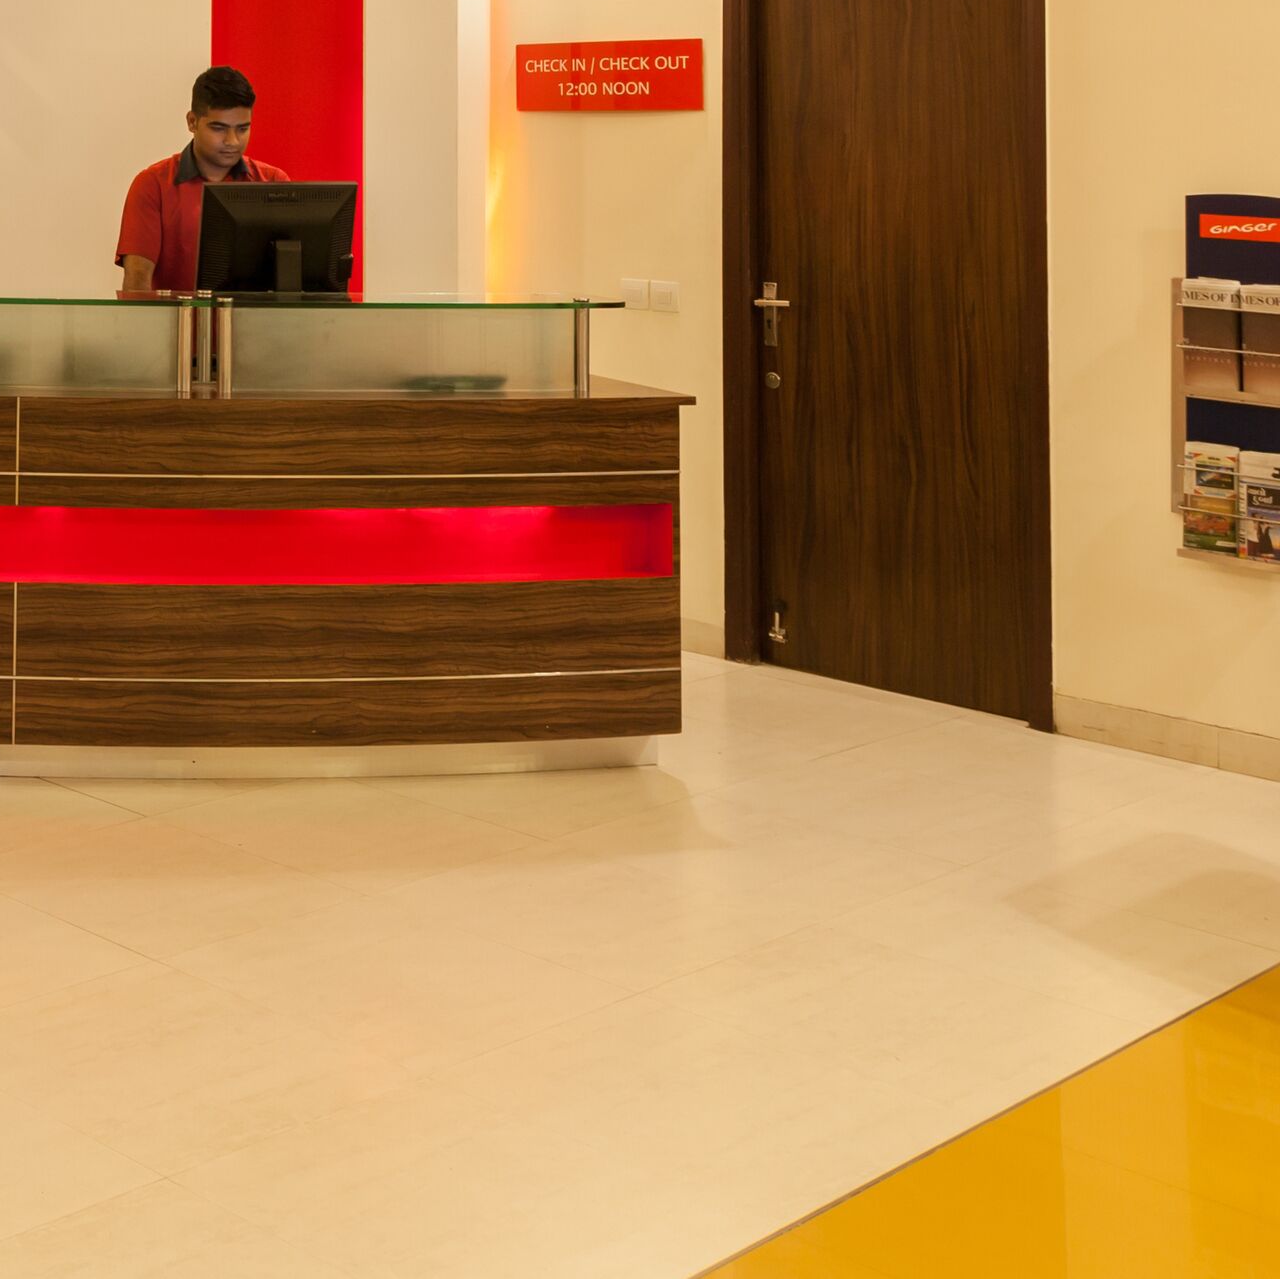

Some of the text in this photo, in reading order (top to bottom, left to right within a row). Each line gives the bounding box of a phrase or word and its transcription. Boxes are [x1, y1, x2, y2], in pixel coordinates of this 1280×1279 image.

[525, 55, 690, 76] CHECK IN / CHECK OUT
[558, 81, 650, 97] 12:00 NOON
[1210, 292, 1228, 303] OF
